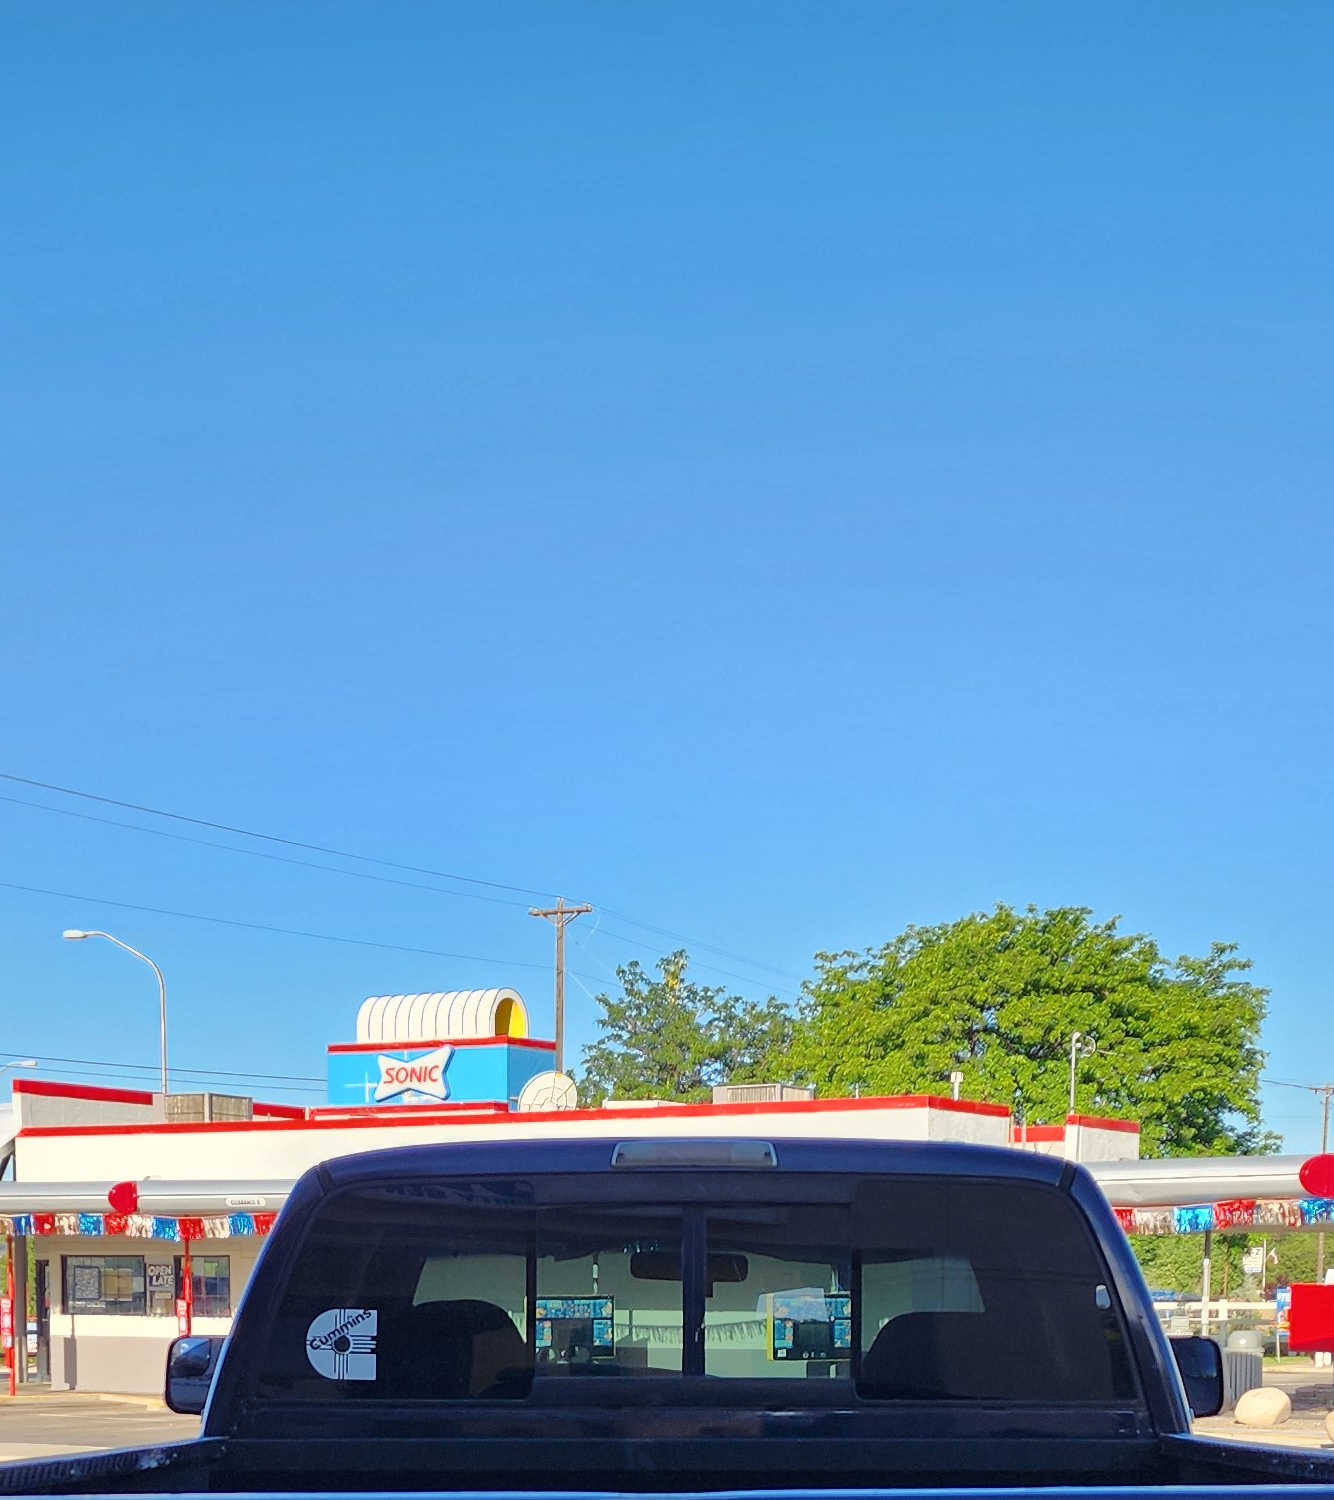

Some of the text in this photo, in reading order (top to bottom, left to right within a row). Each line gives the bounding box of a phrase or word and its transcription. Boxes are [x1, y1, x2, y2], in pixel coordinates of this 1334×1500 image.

[383, 1065, 440, 1084] SONIC
[148, 1265, 172, 1276] OPEN
[152, 1275, 174, 1286] LATE
[309, 1307, 372, 1350] Cummins
